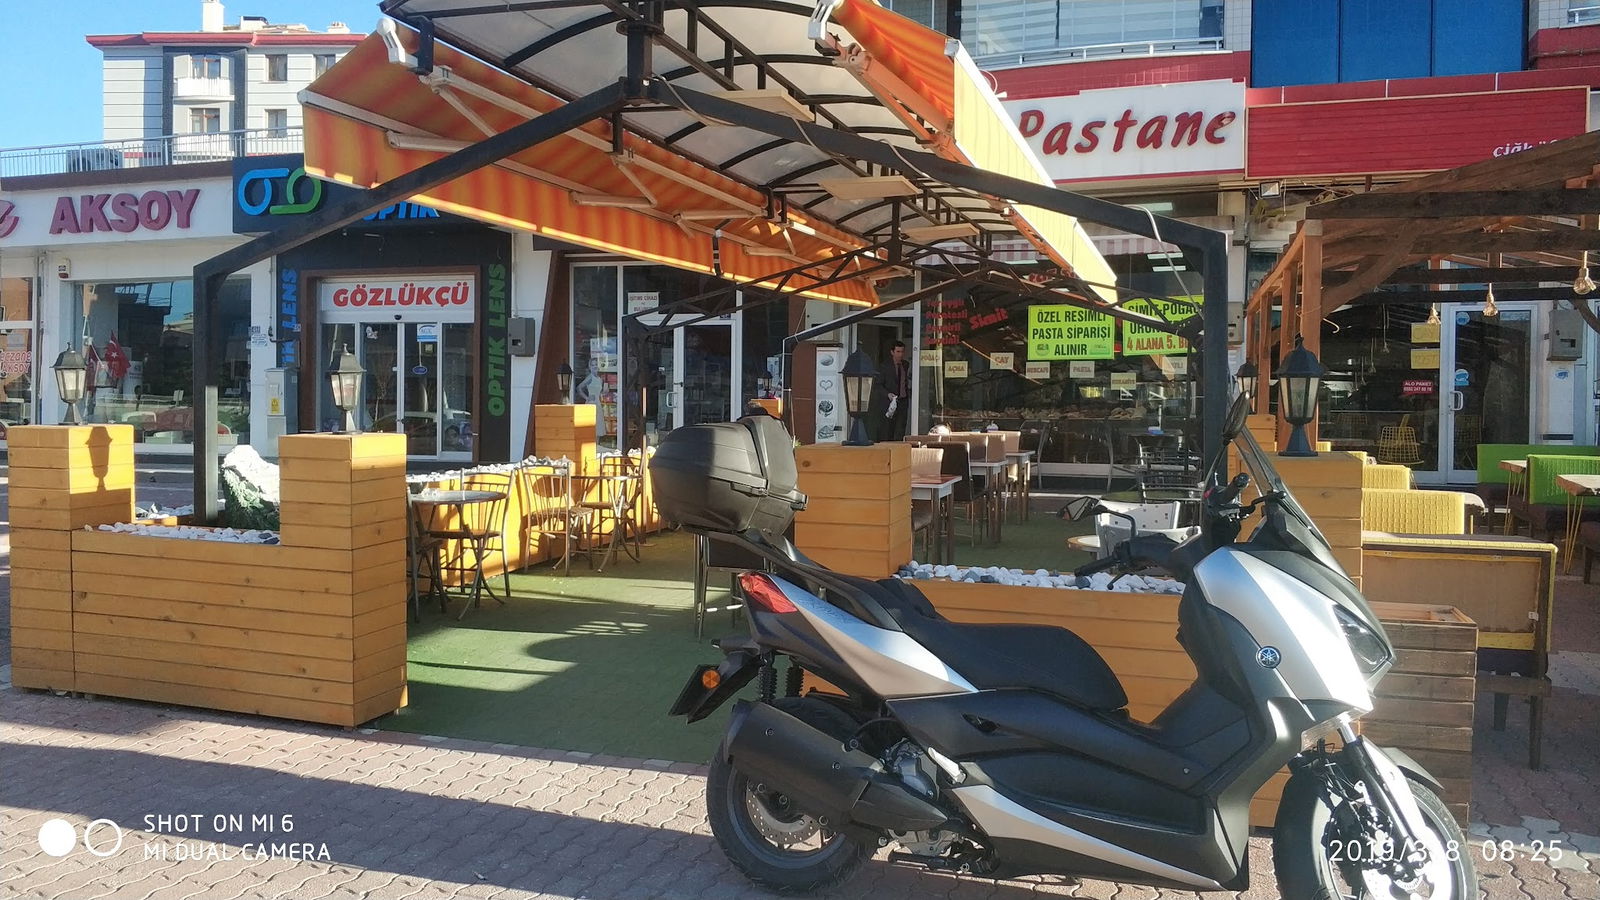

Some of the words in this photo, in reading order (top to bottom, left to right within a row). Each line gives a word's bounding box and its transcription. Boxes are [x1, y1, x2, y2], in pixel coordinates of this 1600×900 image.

[1018, 109, 1236, 155] Pastane
[49, 189, 201, 235] AKSOY
[282, 268, 297, 329] LENS
[333, 281, 470, 308] GÖZLÜKÇÜ
[488, 263, 506, 328] LENS
[1032, 327, 1063, 340] PASTA
[1066, 325, 1111, 341] SİPARİŞİ
[1037, 309, 1061, 323] ÖZEL
[1054, 343, 1088, 356] ALINIR
[1127, 337, 1133, 351] 4
[1136, 337, 1164, 350] ALANA
[1166, 335, 1176, 349] 5.
[488, 337, 506, 417] OPTIK
